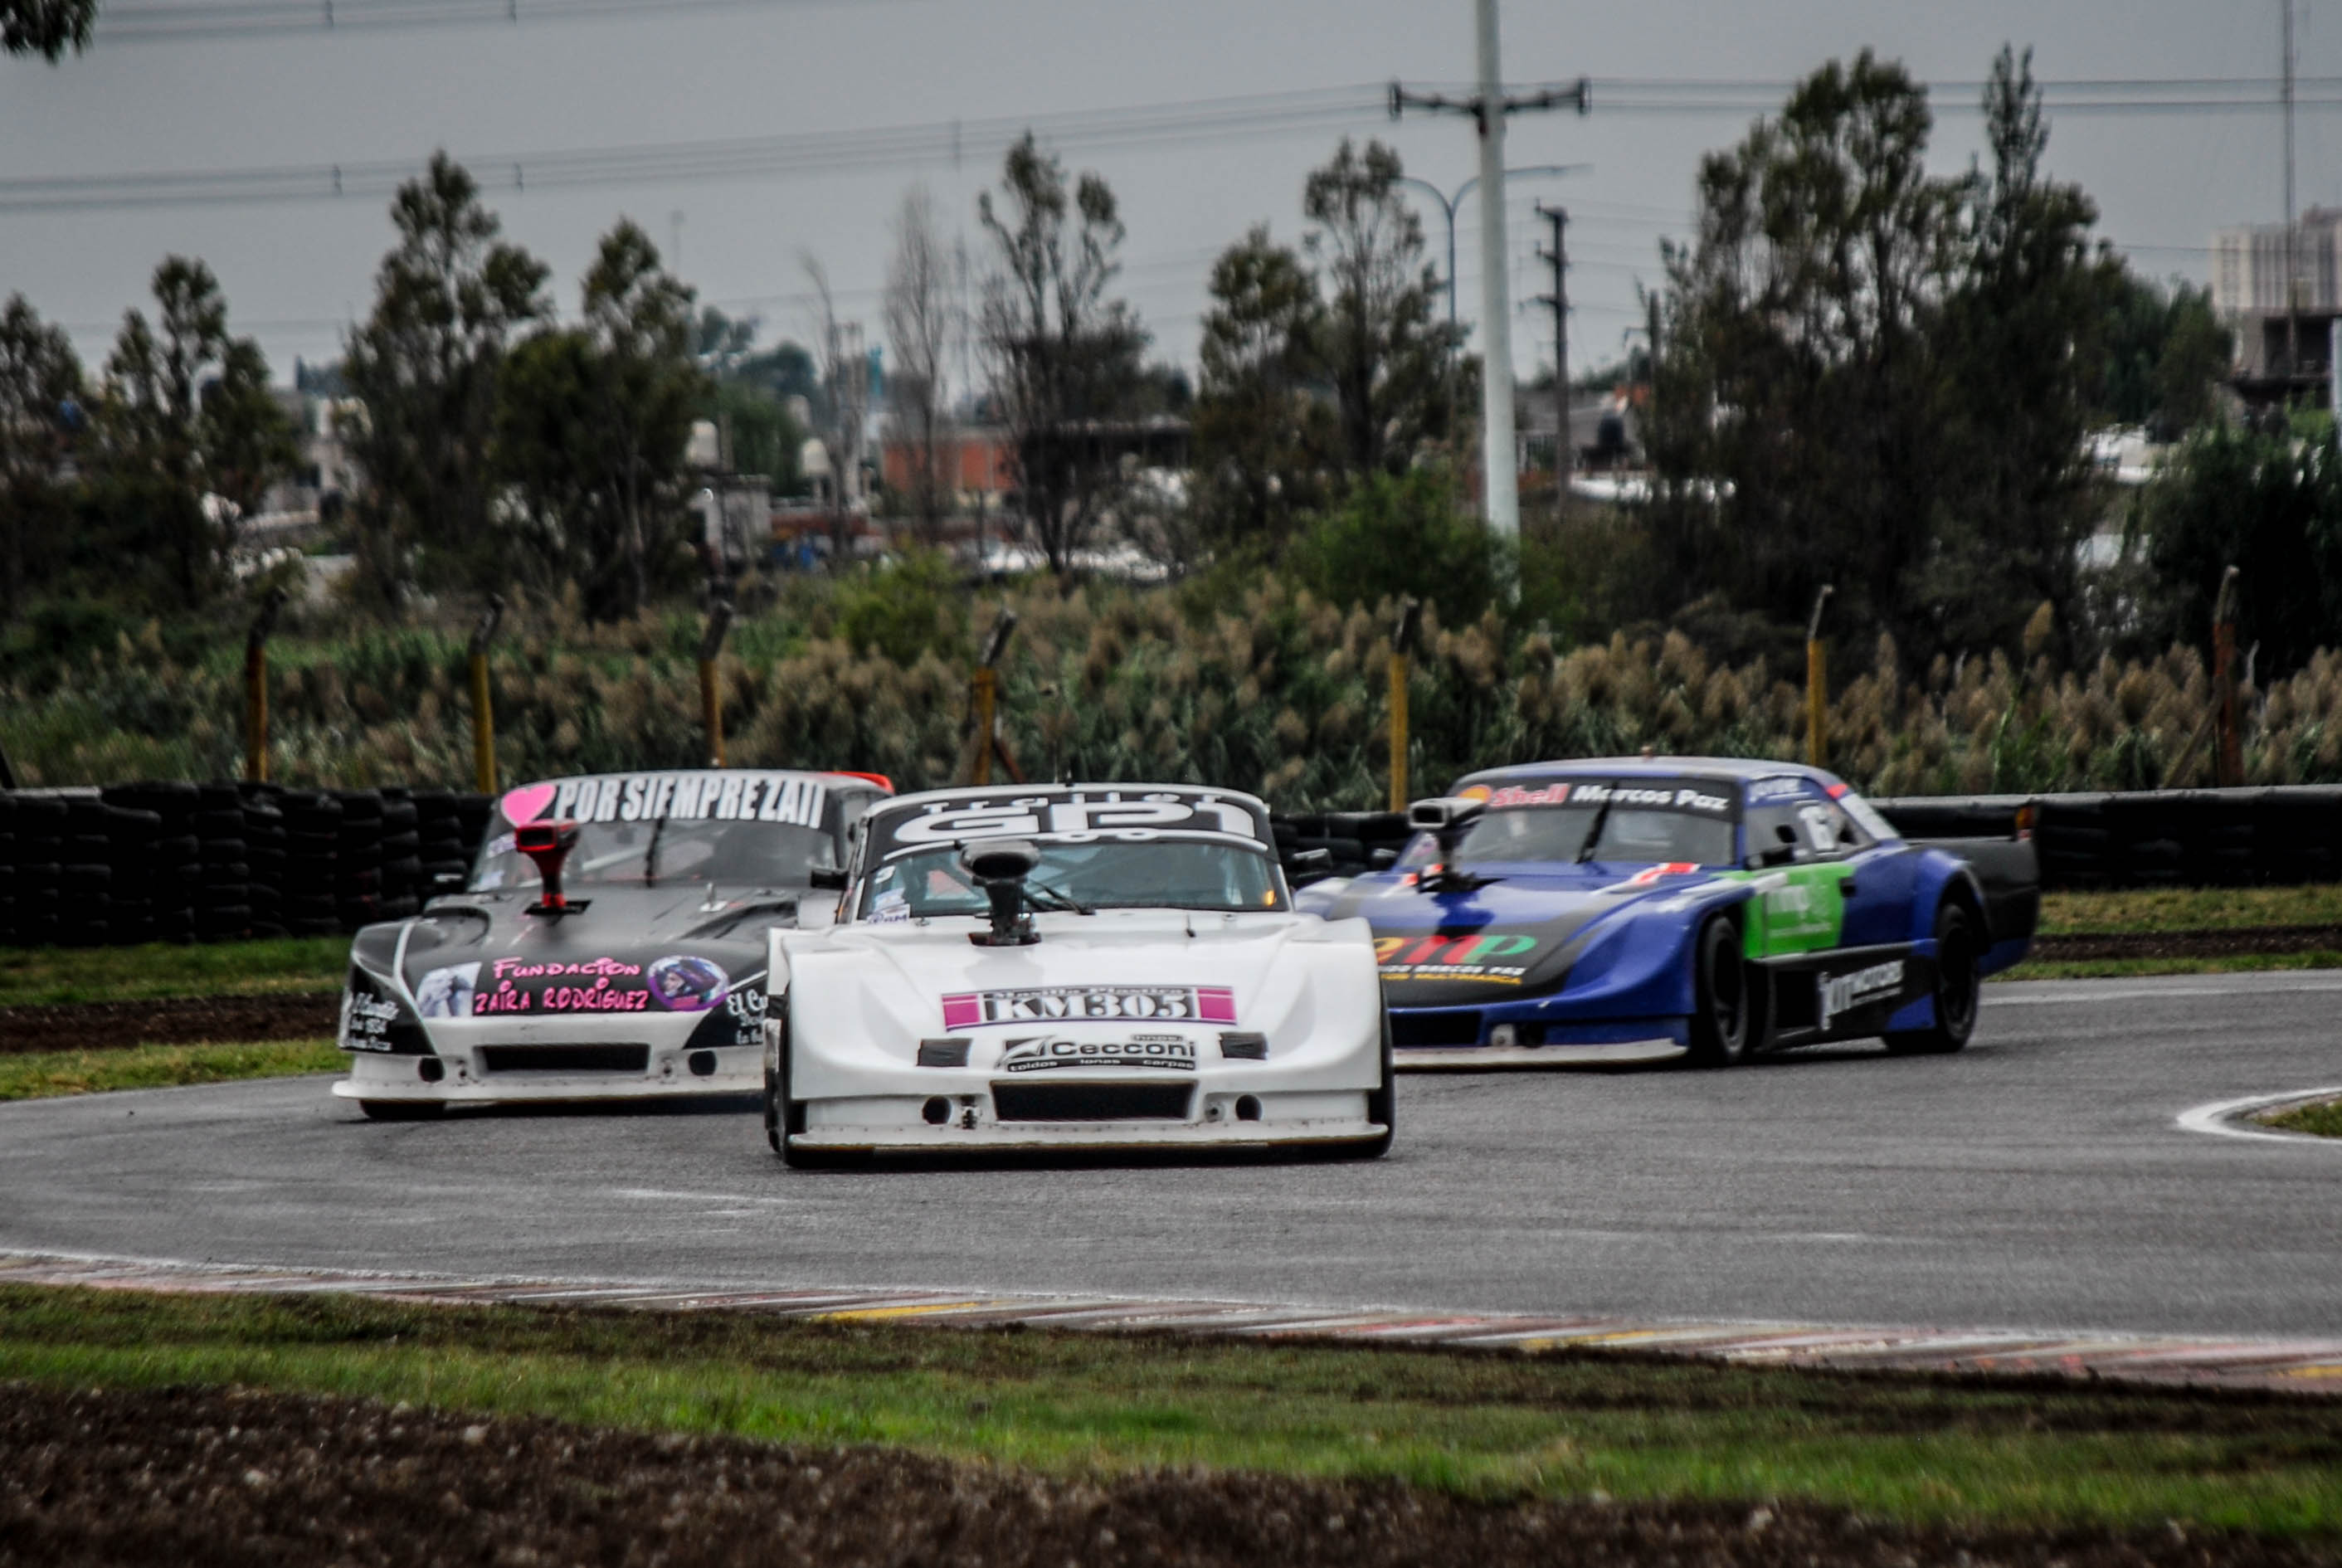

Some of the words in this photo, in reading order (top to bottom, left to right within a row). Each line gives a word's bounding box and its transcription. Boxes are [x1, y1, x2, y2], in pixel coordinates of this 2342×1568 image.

[1490, 783, 1571, 807] Shell
[1573, 785, 1672, 804] Marcos
[1676, 789, 1730, 811] Paz
[992, 995, 1188, 1020] KM305
[1051, 1041, 1195, 1057] Cecconi
[1010, 1060, 1058, 1072] toldos
[1143, 1059, 1194, 1069] carpas
